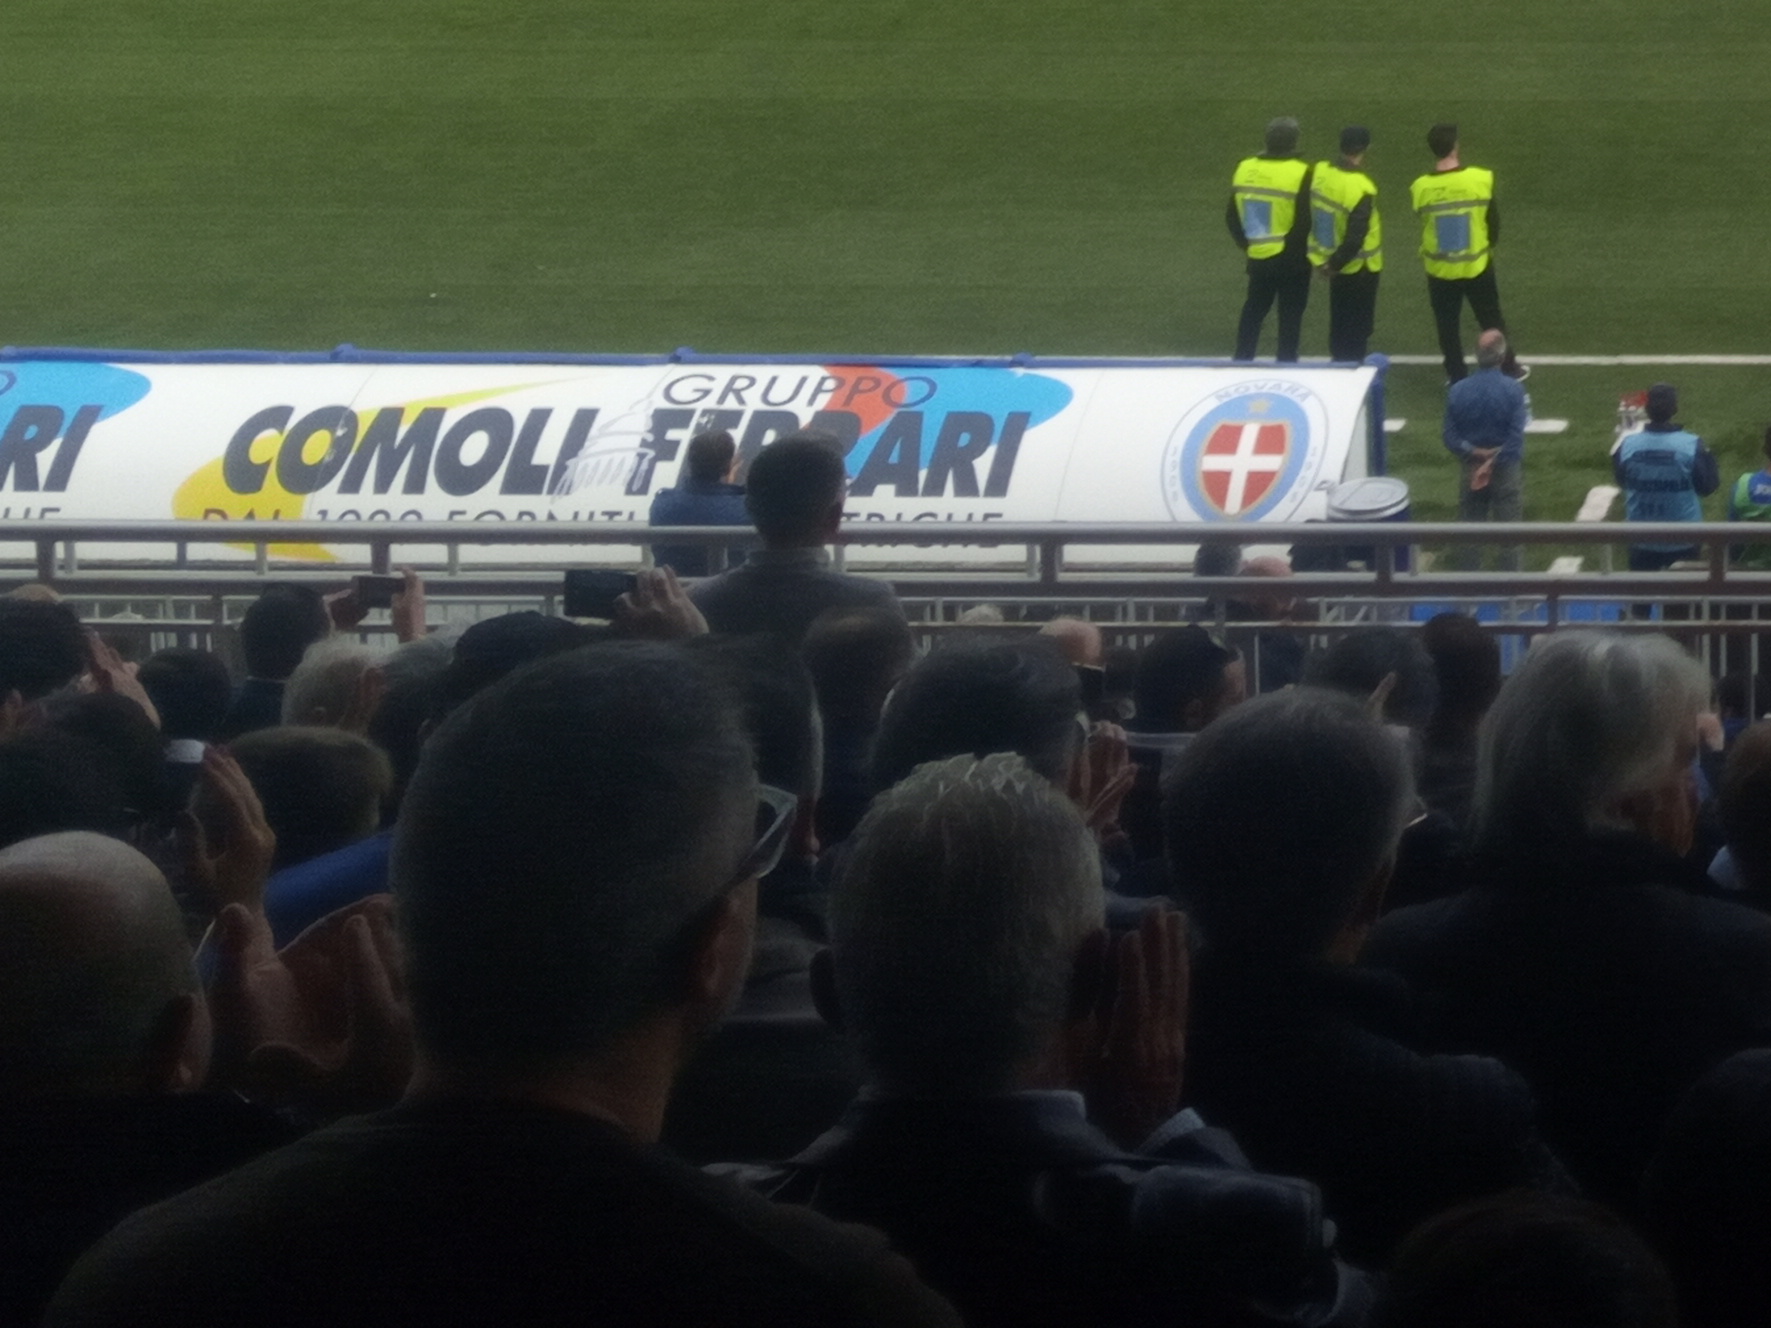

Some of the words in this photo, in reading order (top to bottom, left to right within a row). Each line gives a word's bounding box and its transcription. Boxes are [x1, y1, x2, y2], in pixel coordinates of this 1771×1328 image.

[663, 374, 938, 409] GRUPPO
[1214, 382, 1313, 403] NOVARA
[222, 404, 602, 497] COMOLI
